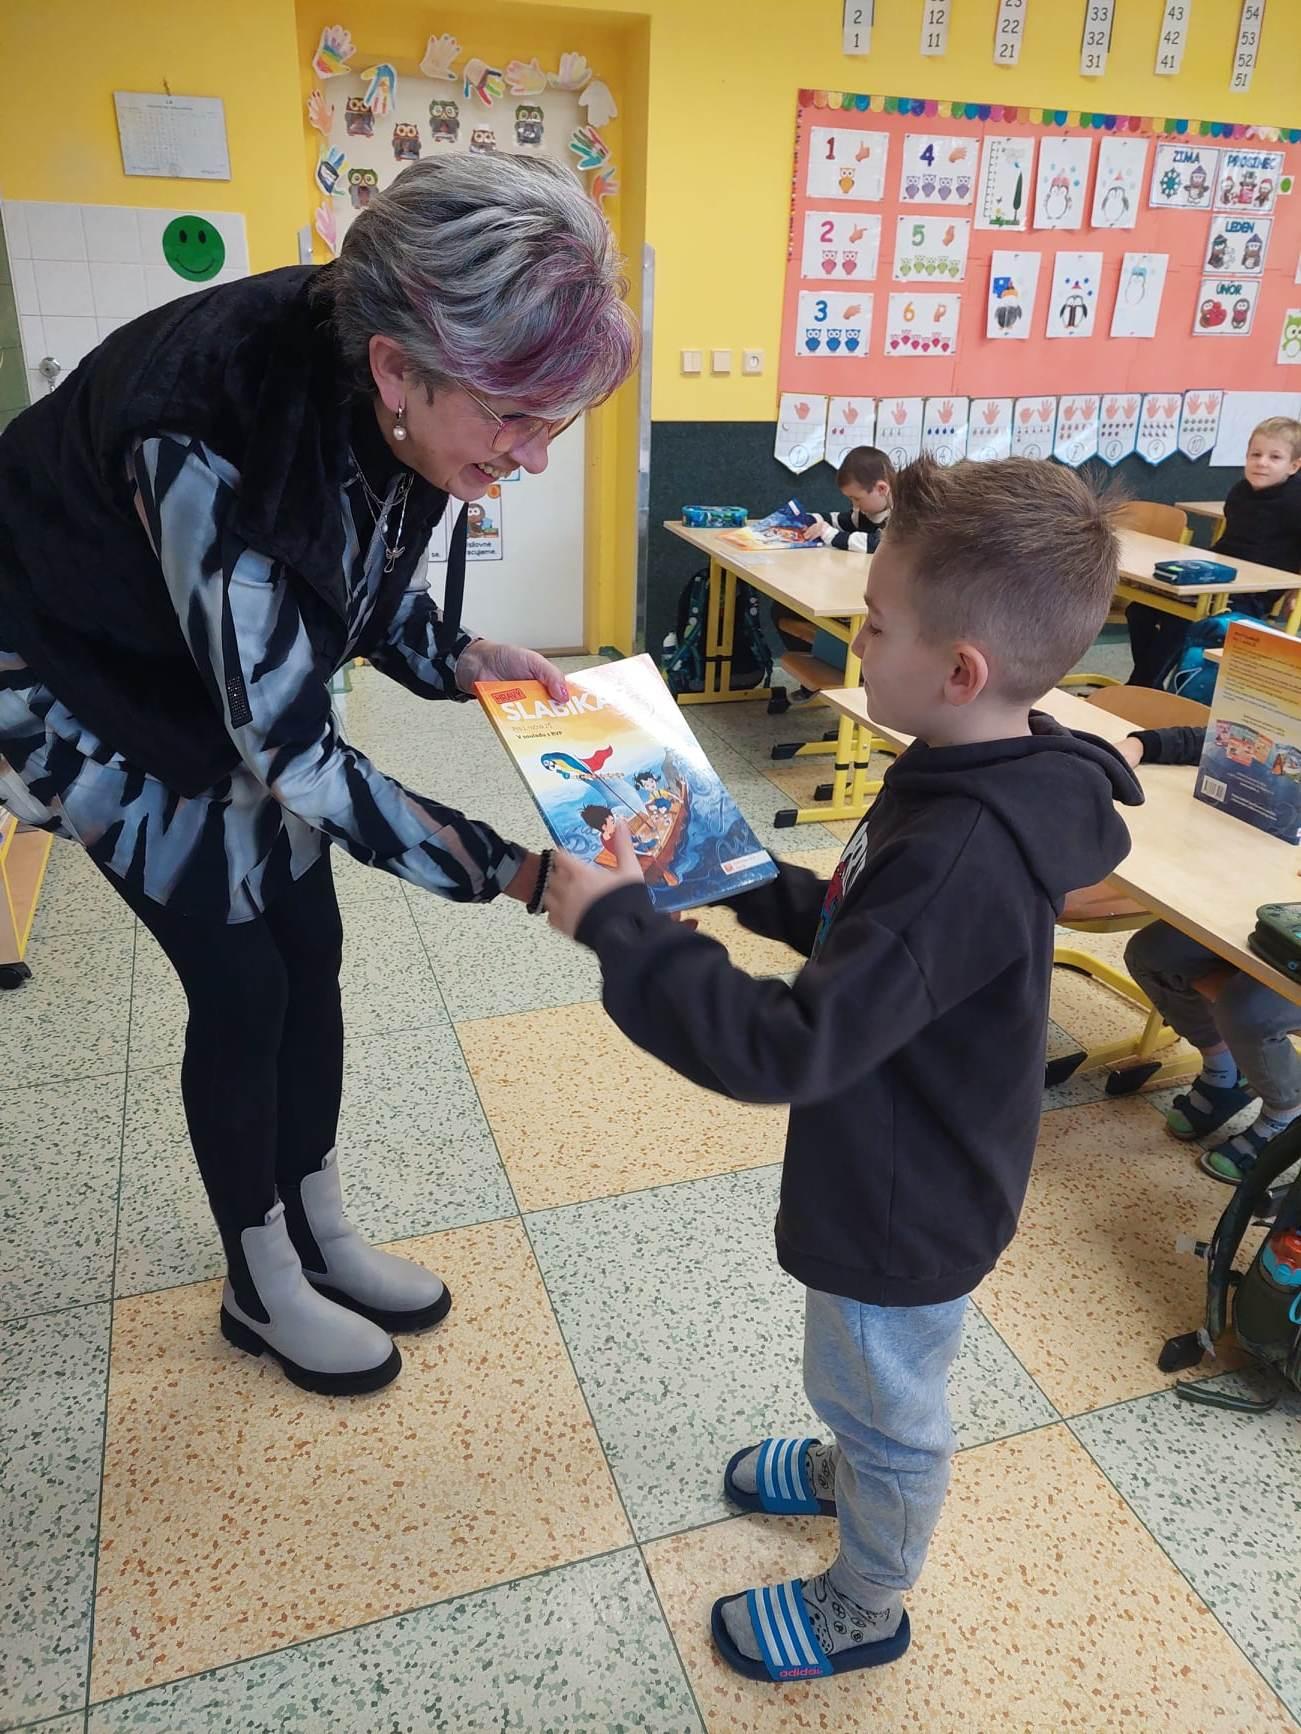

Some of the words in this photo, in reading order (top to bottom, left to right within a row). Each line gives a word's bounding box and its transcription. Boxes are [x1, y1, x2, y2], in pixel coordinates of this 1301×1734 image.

[853, 9, 863, 25] 2
[928, 9, 945, 25] 12
[1091, 6, 1108, 21] 33
[1167, 6, 1184, 21] 43
[1245, 6, 1260, 21] 54
[1001, 19, 1020, 34] 22
[853, 33, 860, 48] 1
[927, 33, 941, 47] 11
[1086, 31, 1105, 46] 32
[1163, 31, 1180, 45] 42
[1241, 31, 1256, 46] 53
[999, 43, 1015, 58] 21
[1085, 54, 1101, 69] 31
[1160, 55, 1175, 69] 41
[1237, 53, 1253, 68] 52
[1233, 72, 1248, 87] 51
[825, 137, 836, 160] 1
[919, 143, 935, 167] 4
[1172, 151, 1200, 164] ZIMA
[820, 221, 834, 243] 2
[1225, 221, 1255, 234] LEDEN
[912, 224, 926, 247] 5
[814, 300, 828, 322] 3
[903, 300, 915, 322] 6
[779, 1667, 823, 1677] adidas
